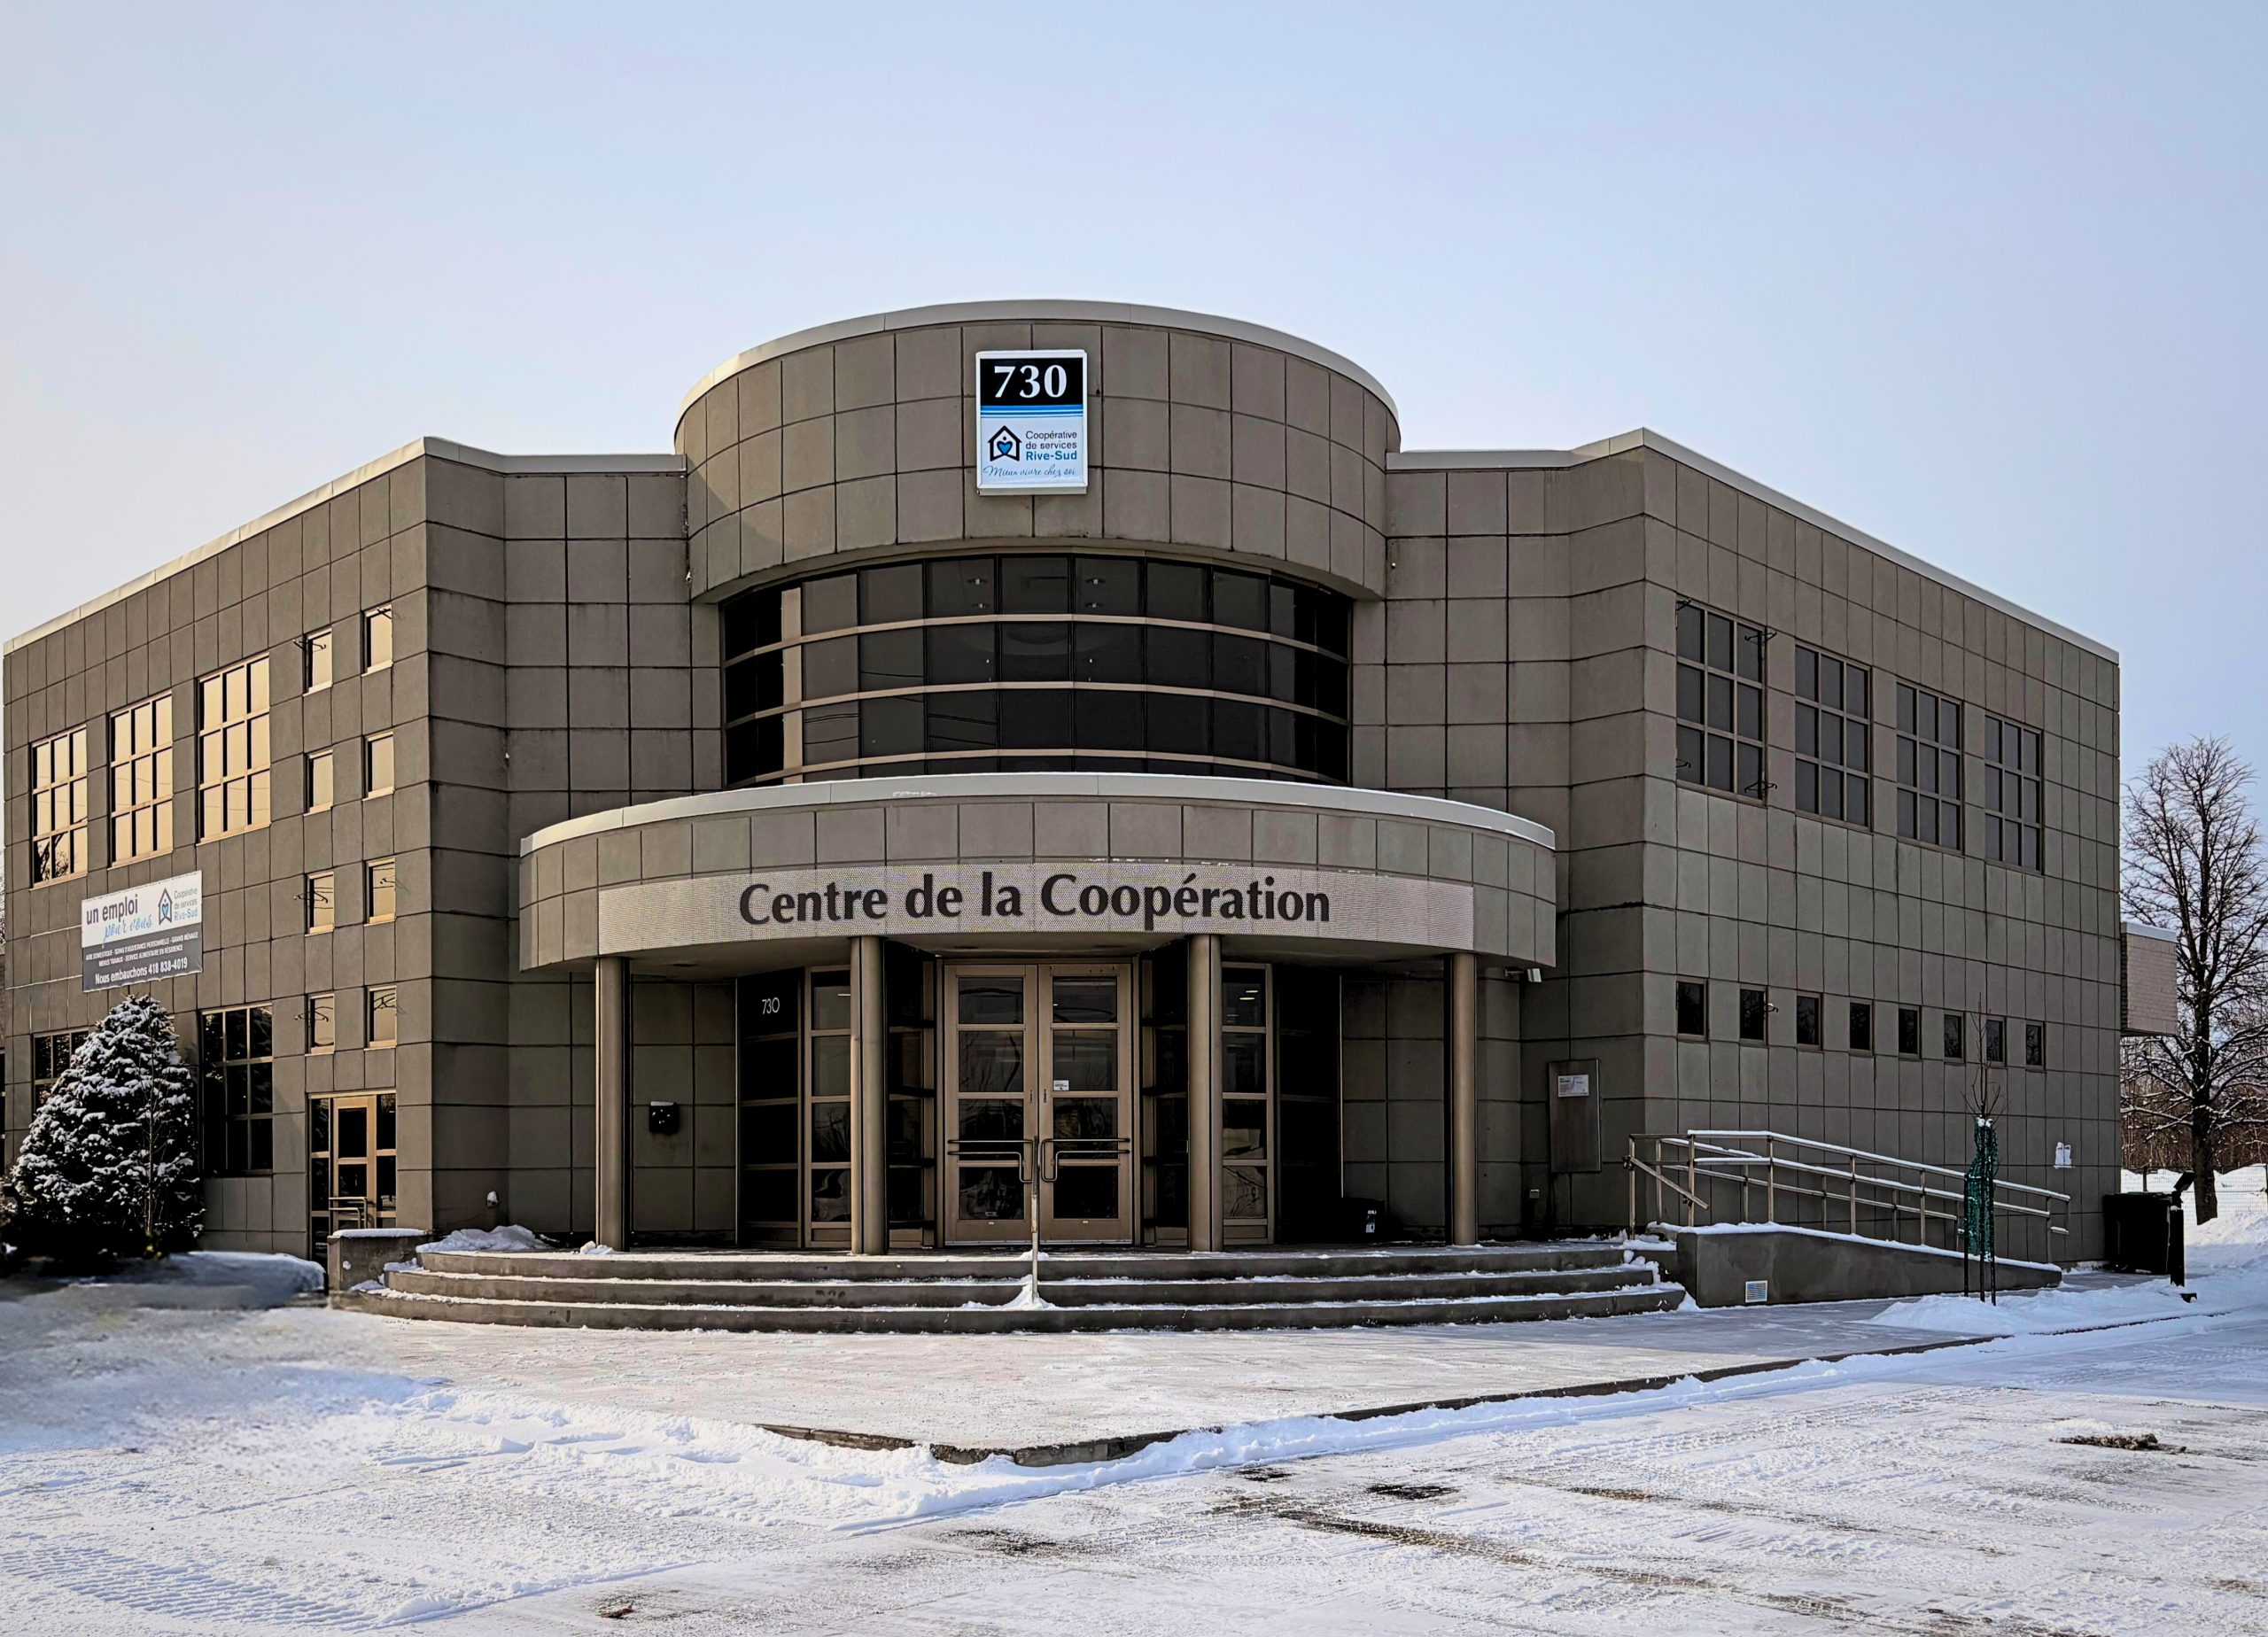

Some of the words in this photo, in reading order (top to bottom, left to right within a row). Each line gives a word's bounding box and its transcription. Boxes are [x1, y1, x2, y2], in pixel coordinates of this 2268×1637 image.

[994, 365, 1067, 399] 730
[1026, 431, 1077, 440] Coopérative
[1040, 441, 1077, 450] services
[1026, 450, 1077, 461] Rive-Sud
[983, 466, 1018, 477] Mieux
[1044, 464, 1062, 477] chez
[87, 908, 99, 925] un
[102, 894, 138, 922] emploi
[181, 899, 198, 909] services
[739, 882, 888, 925] Centre
[905, 873, 963, 919] de
[982, 871, 1023, 917] la
[1040, 873, 1331, 931] Coopération
[103, 919, 127, 943] pour
[129, 914, 153, 931] vous
[95, 974, 110, 985] Nous
[111, 966, 148, 982] embauchons
[149, 962, 159, 974] 418
[160, 957, 188, 973] 838-4019
[762, 997, 780, 1014] 730
